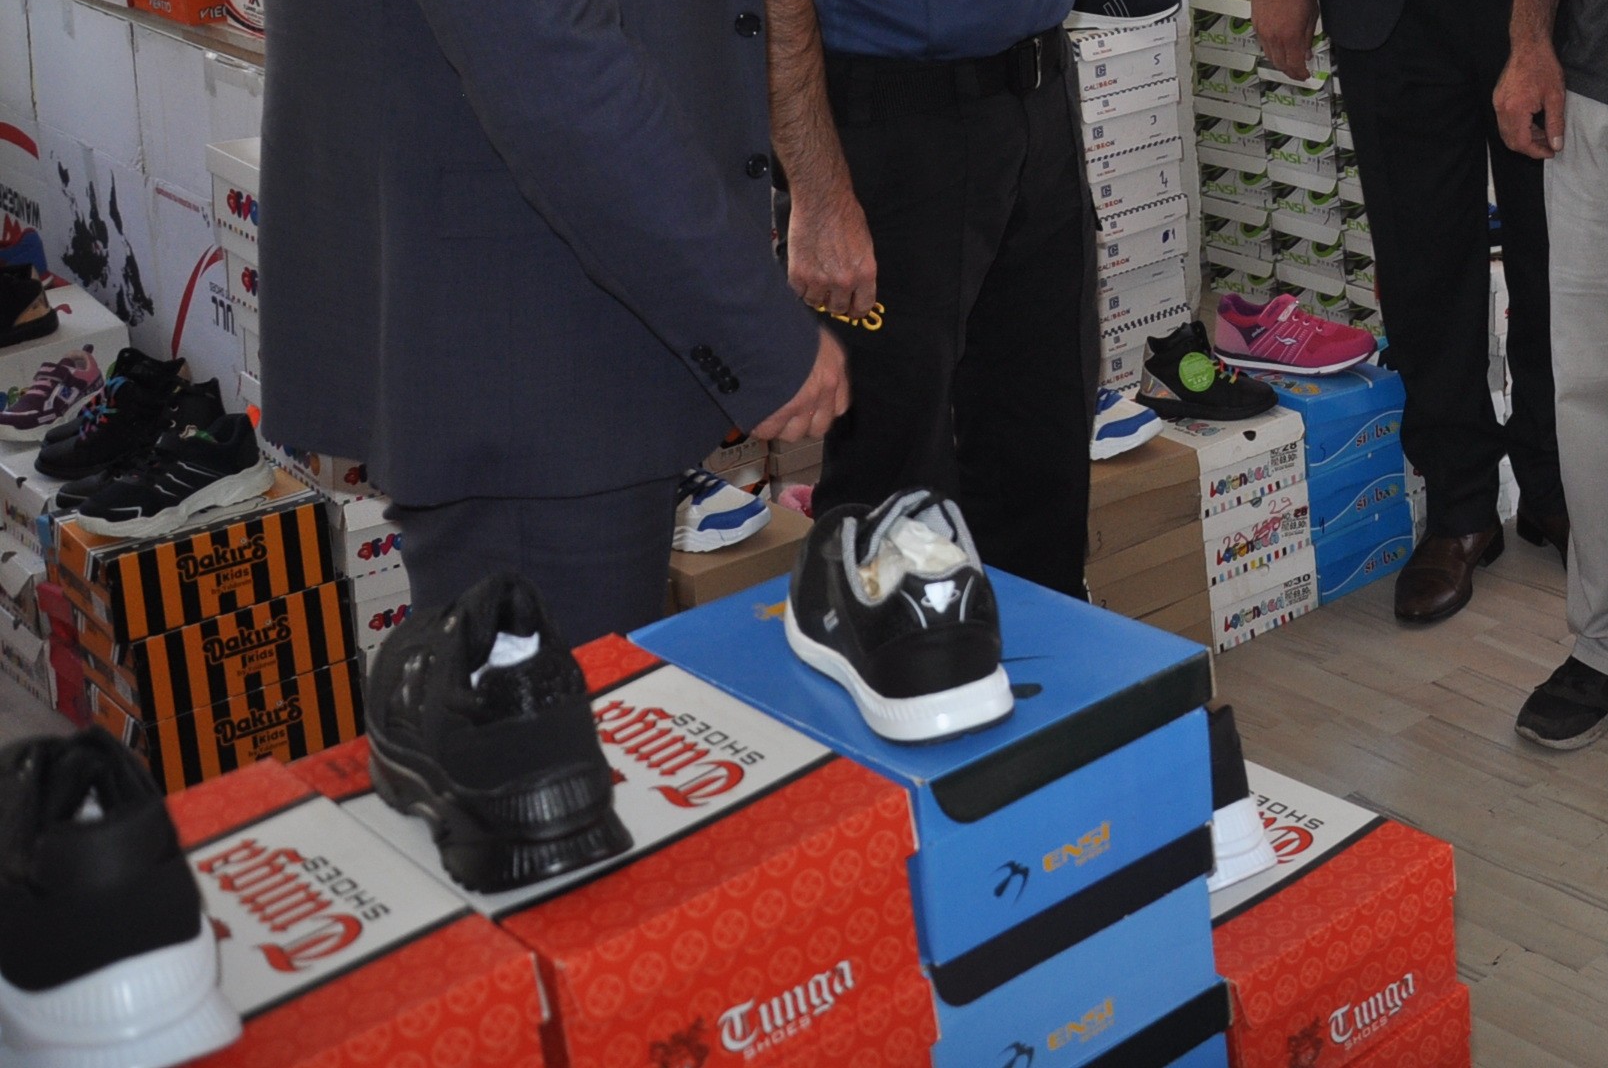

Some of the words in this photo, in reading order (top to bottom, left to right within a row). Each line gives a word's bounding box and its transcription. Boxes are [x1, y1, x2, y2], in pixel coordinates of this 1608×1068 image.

[1344, 166, 1359, 179] EN
[1293, 573, 1311, 585] 30
[671, 712, 766, 767] SHOES
[1253, 792, 1325, 830] SHOE
[1043, 821, 1110, 872] ENSI
[301, 855, 393, 923] SHOES
[717, 960, 855, 1052] Tunga
[1047, 997, 1114, 1051] ENSI
[1329, 972, 1416, 1045] Tunga
[743, 1014, 811, 1061] SHOES
[1344, 1016, 1389, 1051] SHOES
